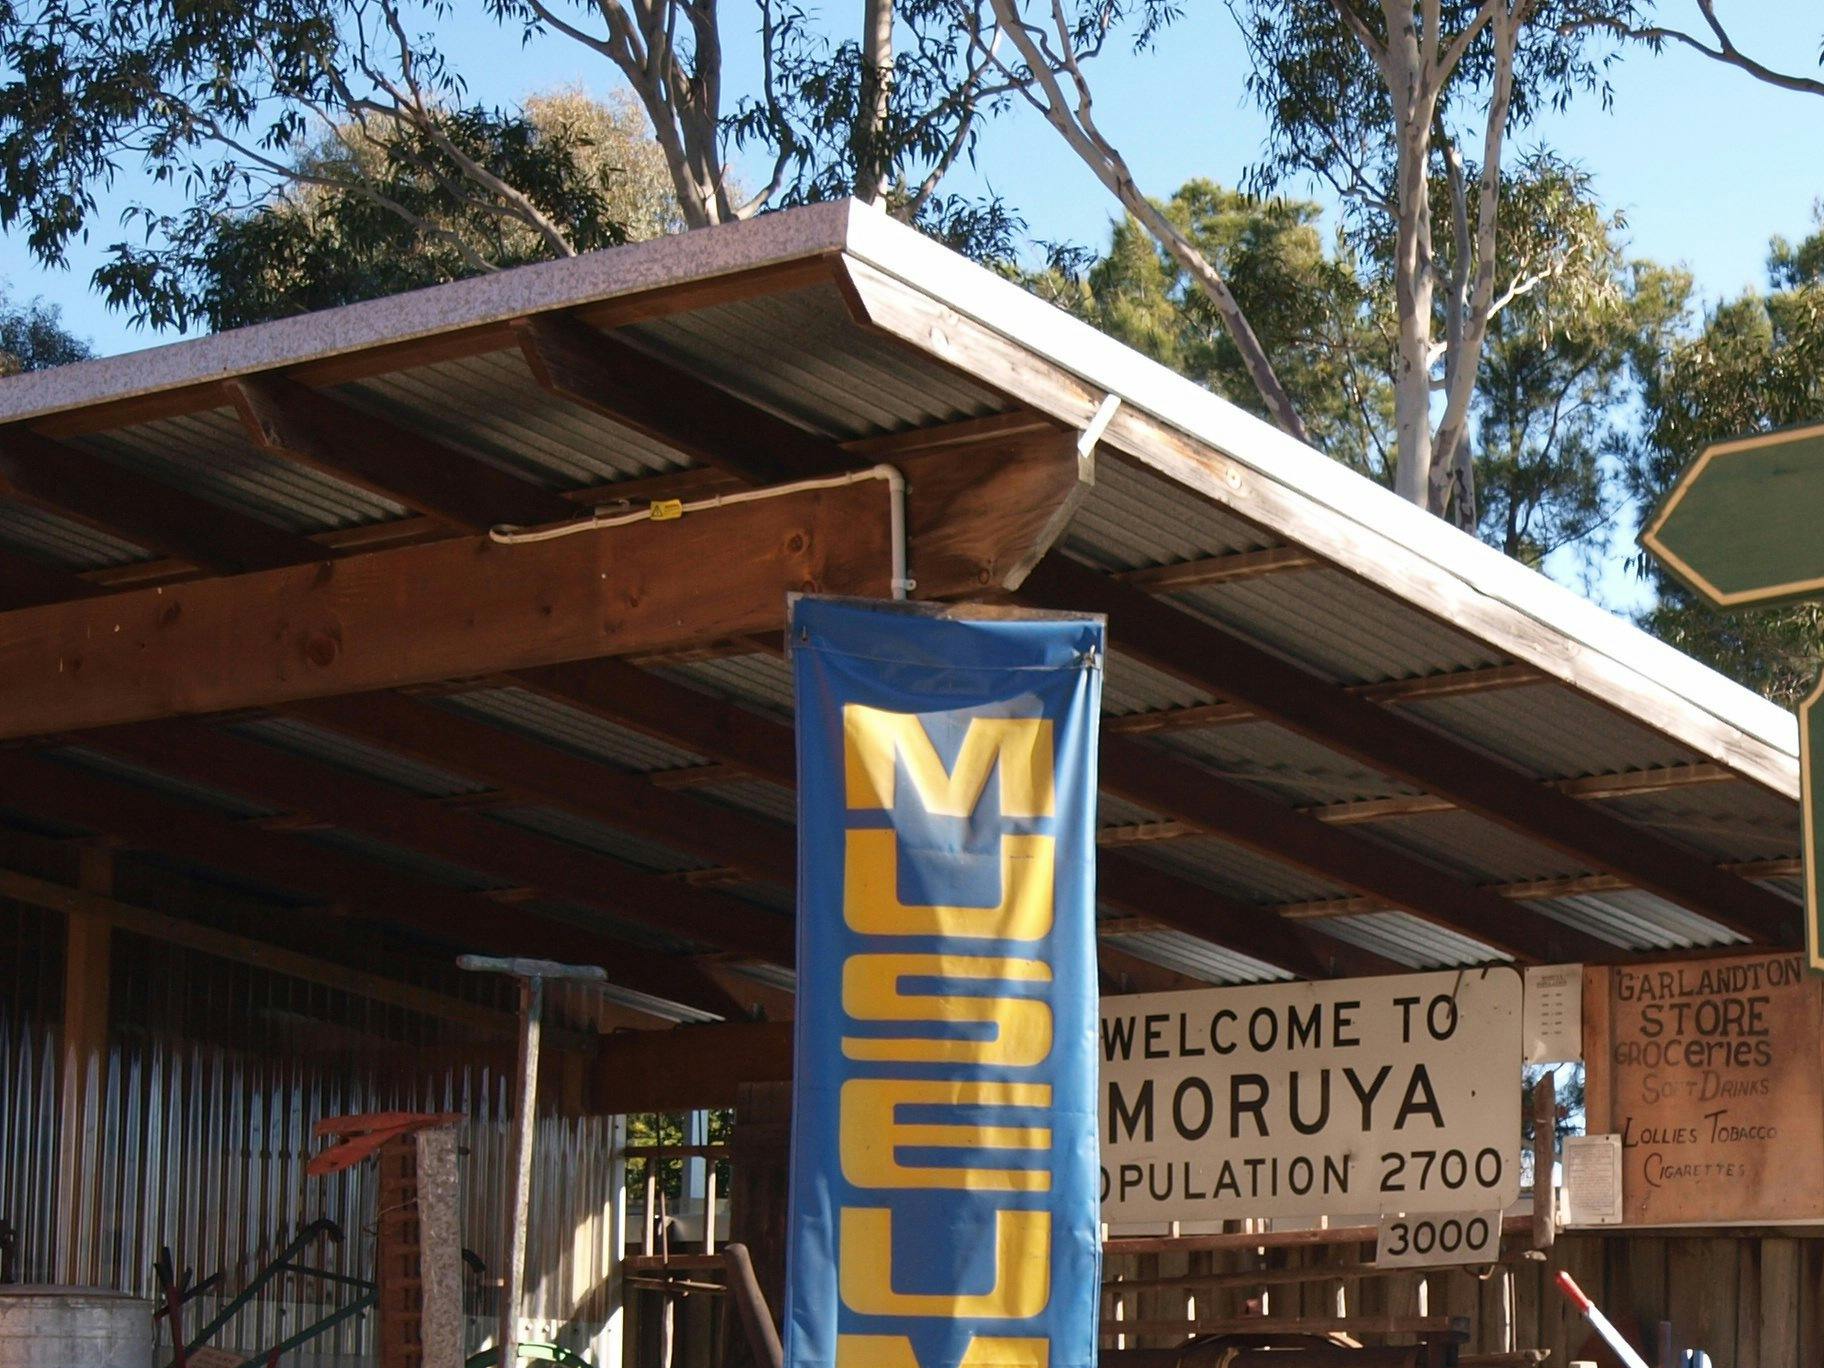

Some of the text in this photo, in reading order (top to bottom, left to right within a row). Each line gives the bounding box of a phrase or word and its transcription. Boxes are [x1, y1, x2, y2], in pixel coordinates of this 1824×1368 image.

[1618, 956, 1803, 1003] GARLANDTON
[1102, 994, 1458, 1062] WELCOME TO
[1639, 996, 1770, 1038] STORE
[1108, 1063, 1446, 1145] MORUYA
[1642, 1073, 1697, 1105] SOT
[1623, 1109, 1778, 1148] LOLLIES TOBACCO
[1100, 1147, 1502, 1204] PULATION 2700
[1643, 1152, 1745, 1188] CIGARETTES
[1387, 1216, 1489, 1256] 3000
